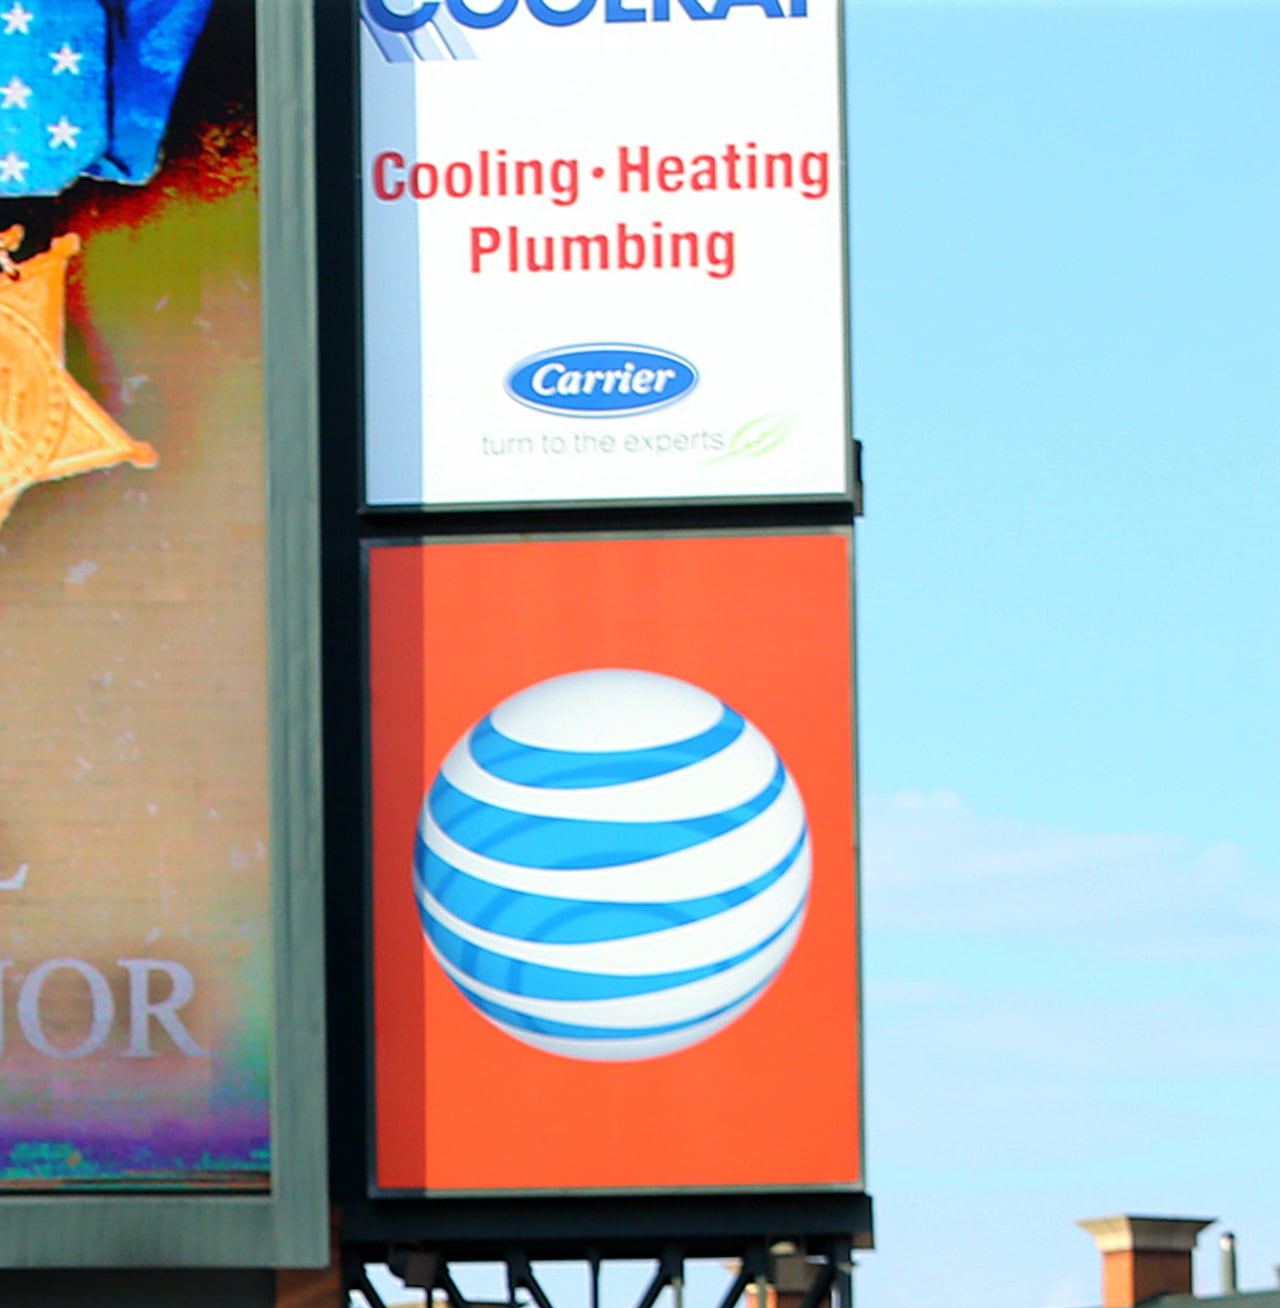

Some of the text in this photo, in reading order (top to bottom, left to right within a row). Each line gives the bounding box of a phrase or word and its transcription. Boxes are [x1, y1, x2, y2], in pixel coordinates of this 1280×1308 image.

[469, 222, 736, 279] Plumbing
[532, 360, 676, 397] Carrier
[482, 430, 726, 456] turn to the experts
